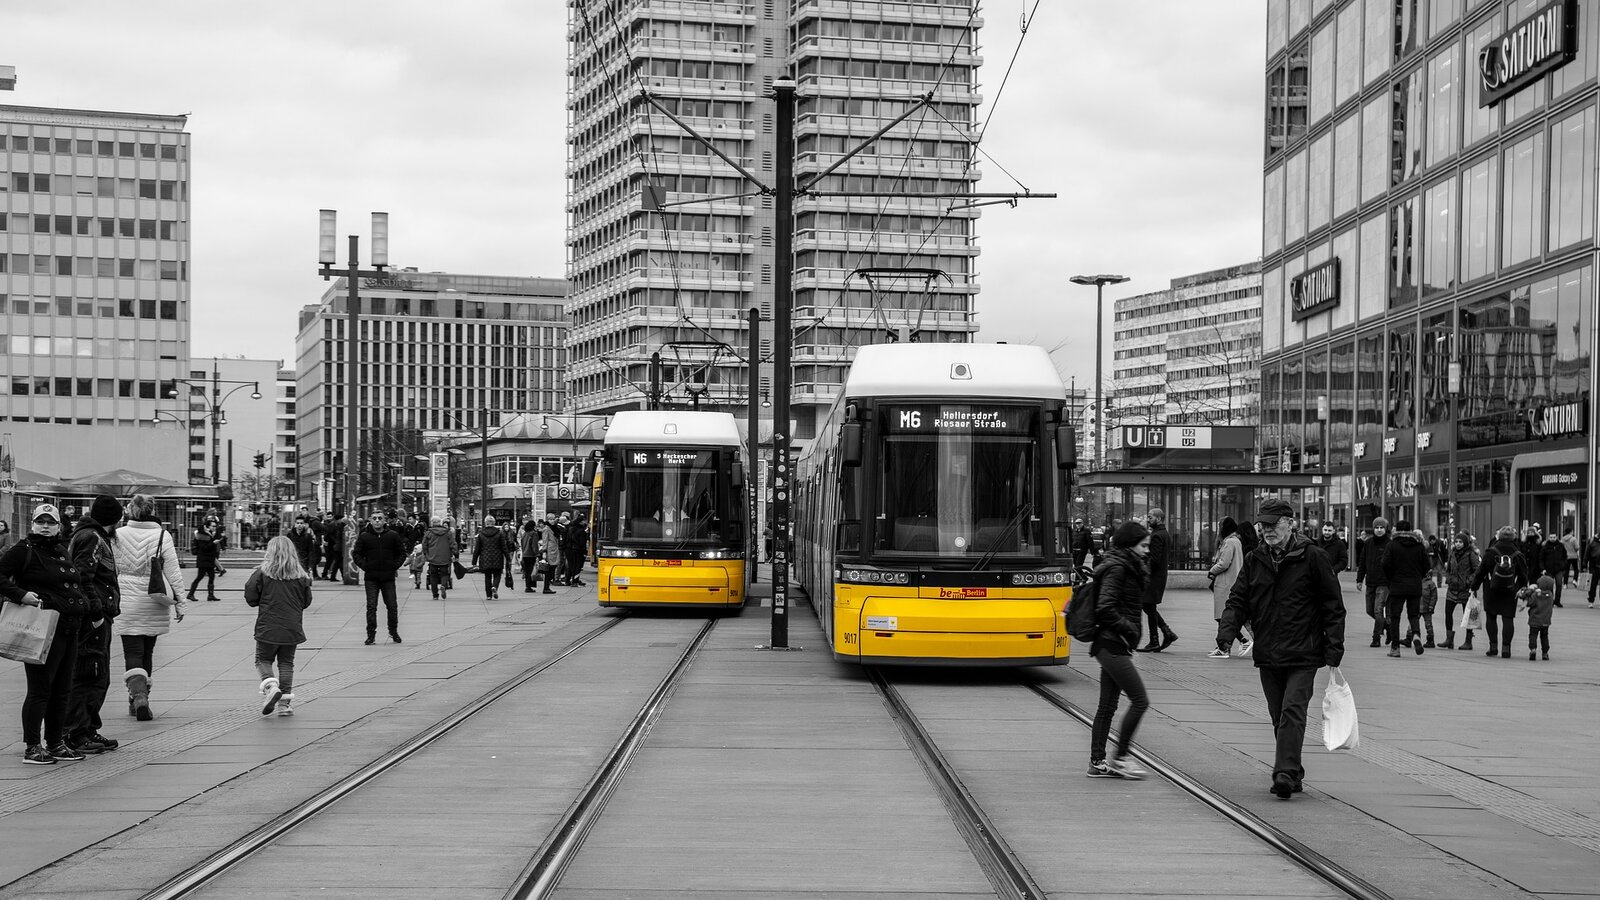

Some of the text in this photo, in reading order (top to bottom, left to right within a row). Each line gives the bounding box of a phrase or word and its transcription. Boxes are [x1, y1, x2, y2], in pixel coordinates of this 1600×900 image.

[1501, 5, 1557, 84] SATURN
[1302, 264, 1332, 310] SATURN
[900, 410, 921, 428] M6
[943, 411, 998, 420] Hellersdorf
[1543, 403, 1578, 436] SATURN
[934, 419, 1007, 428] Riesaer Straße
[1127, 427, 1142, 447] U
[633, 452, 648, 465] M6
[966, 589, 985, 597] Berlin
[844, 632, 857, 645] 9017
[1056, 635, 1067, 648] 9017
